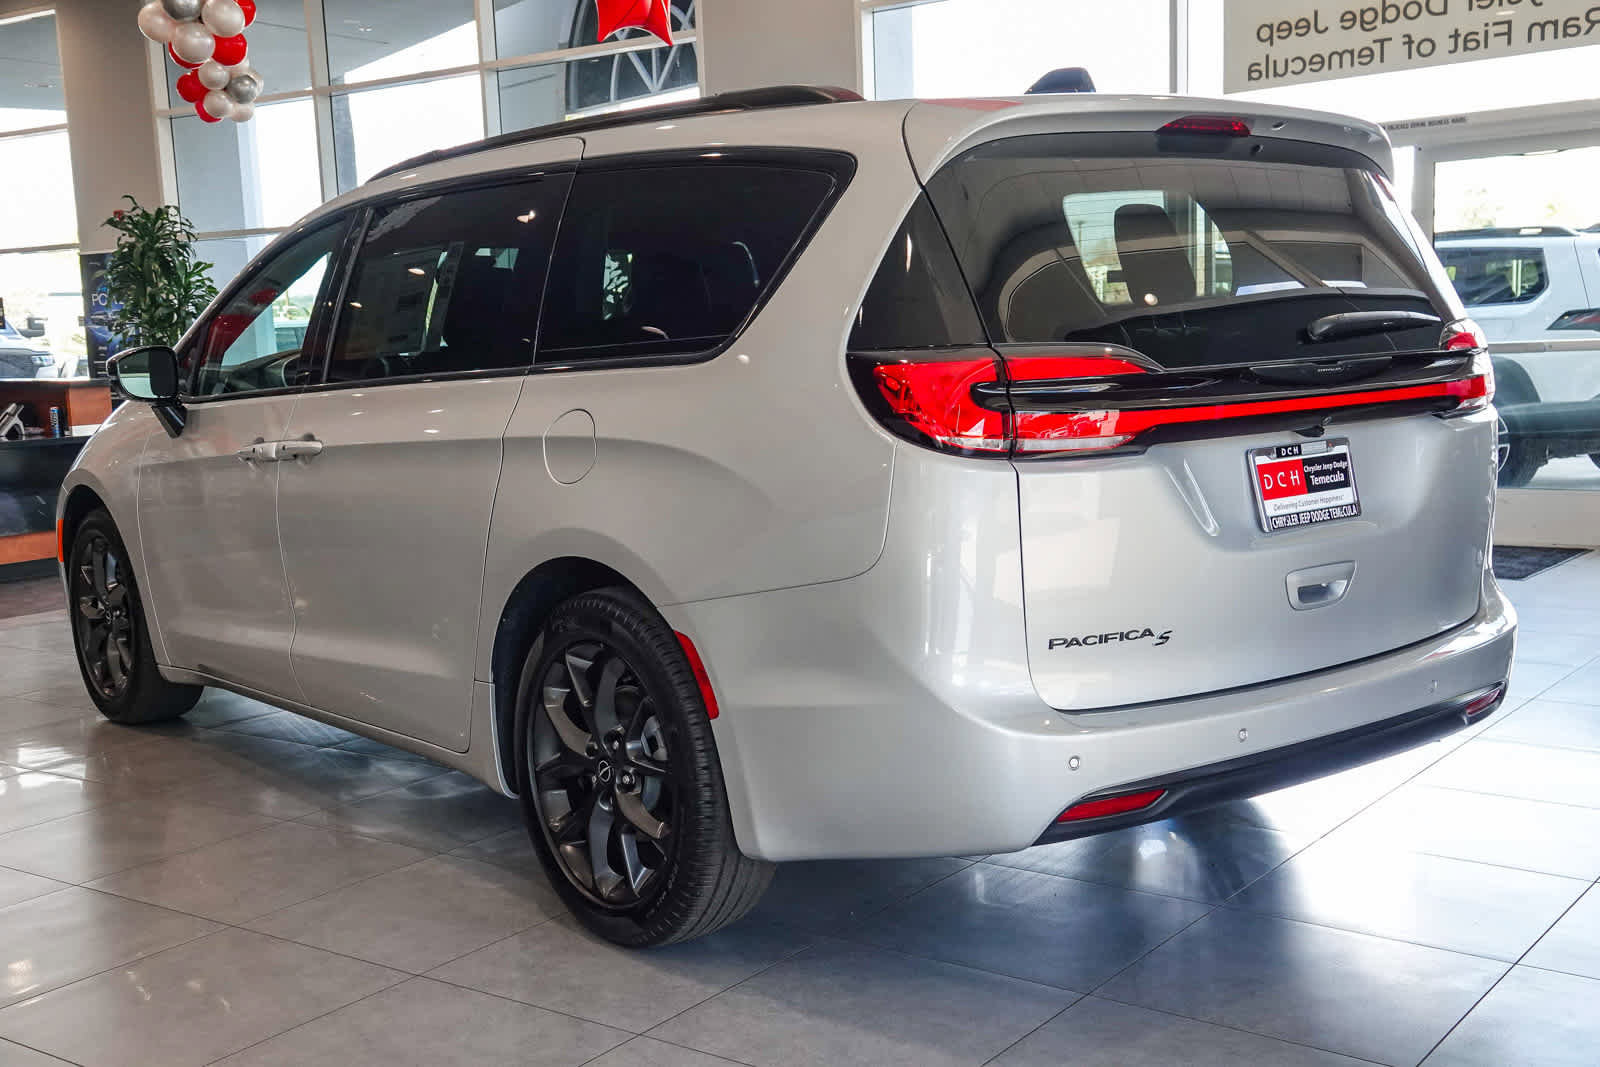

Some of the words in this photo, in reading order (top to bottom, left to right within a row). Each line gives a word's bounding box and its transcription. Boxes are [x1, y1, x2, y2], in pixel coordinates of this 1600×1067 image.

[1310, 470, 1345, 485] Temecula
[1272, 513, 1299, 529] CHRYSLER
[1299, 511, 1311, 524] JEEP
[1311, 508, 1330, 522] DODGE
[1048, 627, 1155, 650] PACIFICA
[1152, 630, 1173, 646] S
